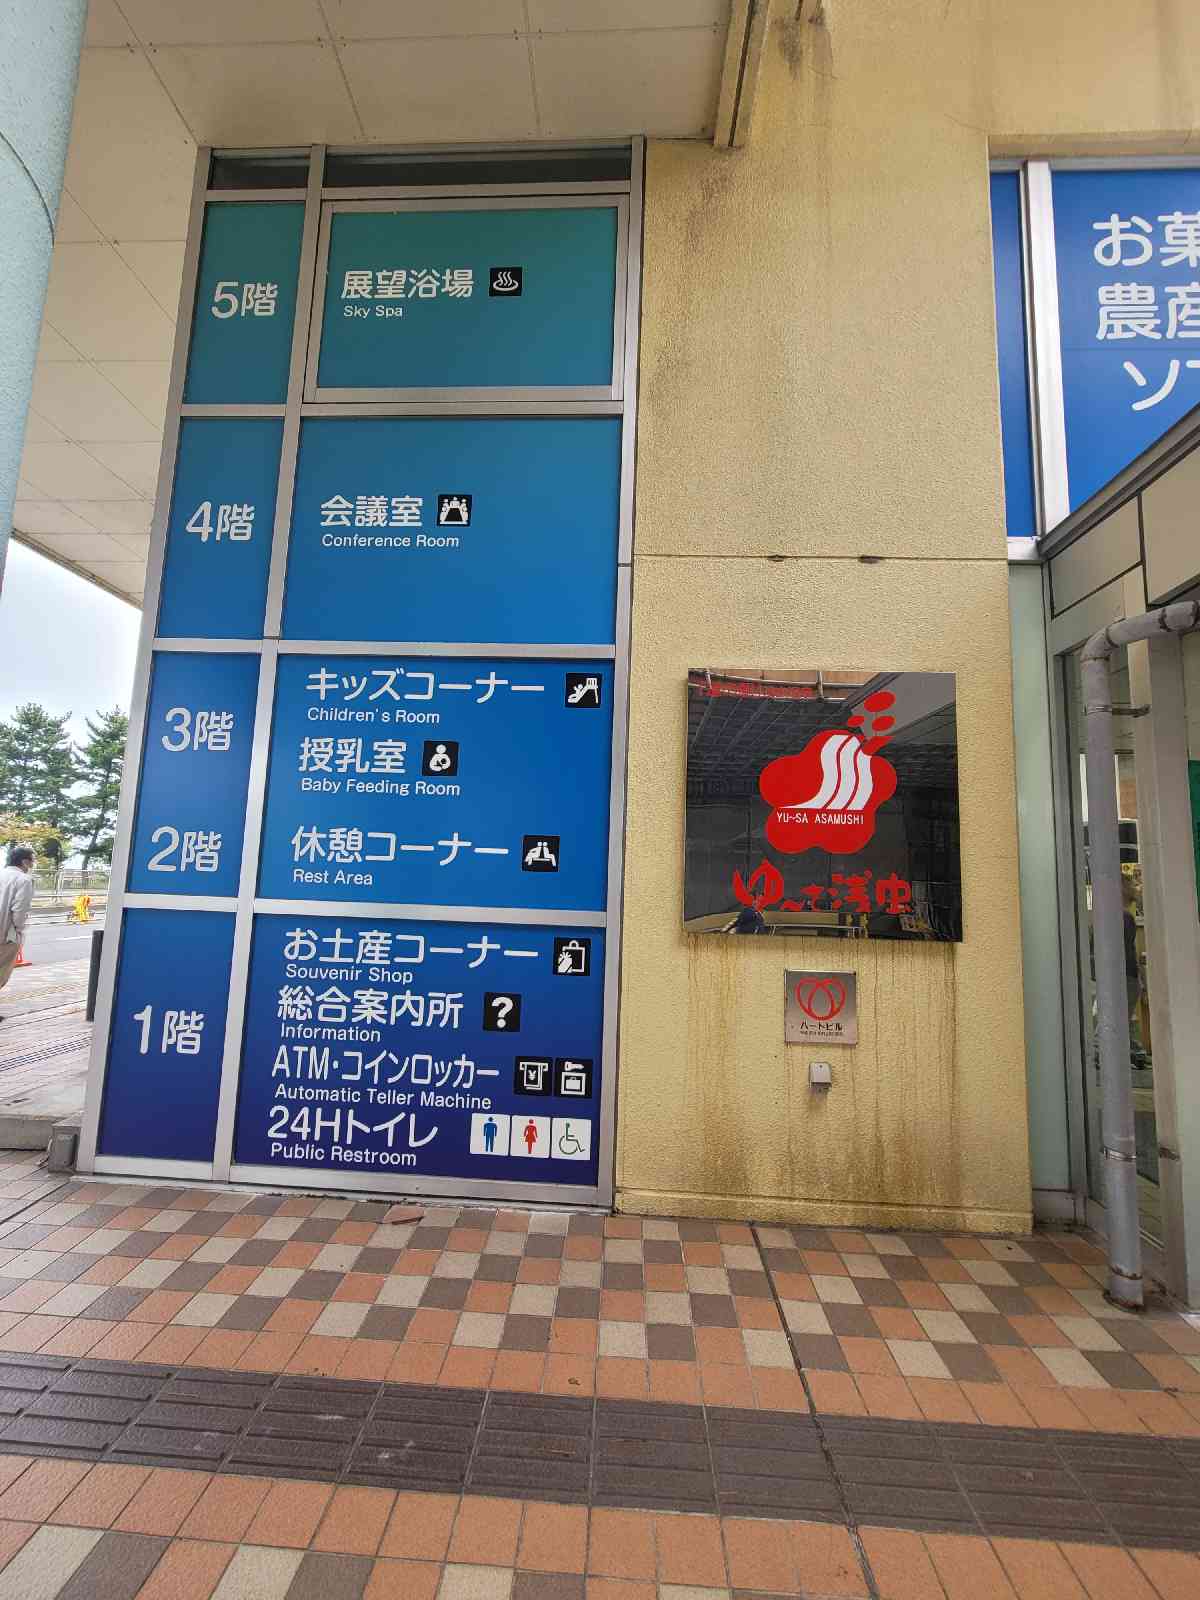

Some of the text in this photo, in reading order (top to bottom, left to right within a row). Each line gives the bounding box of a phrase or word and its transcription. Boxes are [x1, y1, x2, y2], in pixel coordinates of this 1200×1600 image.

[212, 282, 277, 318] 5階
[342, 269, 473, 298] 展望浴場
[344, 306, 403, 319] Sky Spa
[1123, 359, 1200, 410] ソ
[186, 502, 254, 541] 4階
[321, 495, 422, 526] 会議室
[323, 534, 458, 546] Conference Room
[307, 668, 544, 703] キッズコーナー
[162, 708, 233, 751] 3階
[308, 708, 439, 723] Children's Room
[299, 737, 406, 773] 授乳室
[302, 778, 459, 796] Baby Feeding Room
[815, 812, 864, 825] ASAMUSHI
[148, 826, 221, 871] 2階
[292, 826, 508, 865] 休憩コーナー
[294, 869, 372, 885] Rest Area
[284, 928, 538, 969] お土産コーナー
[286, 965, 413, 985] Souvenir Shop
[278, 985, 464, 1029] 総合案内所
[134, 1005, 203, 1054] 1階
[281, 1024, 381, 1043] Information
[275, 1083, 492, 1110] Automatic Teller Machine
[267, 1105, 438, 1149] 24Hトイレ
[271, 1142, 417, 1166] Public Restroom
